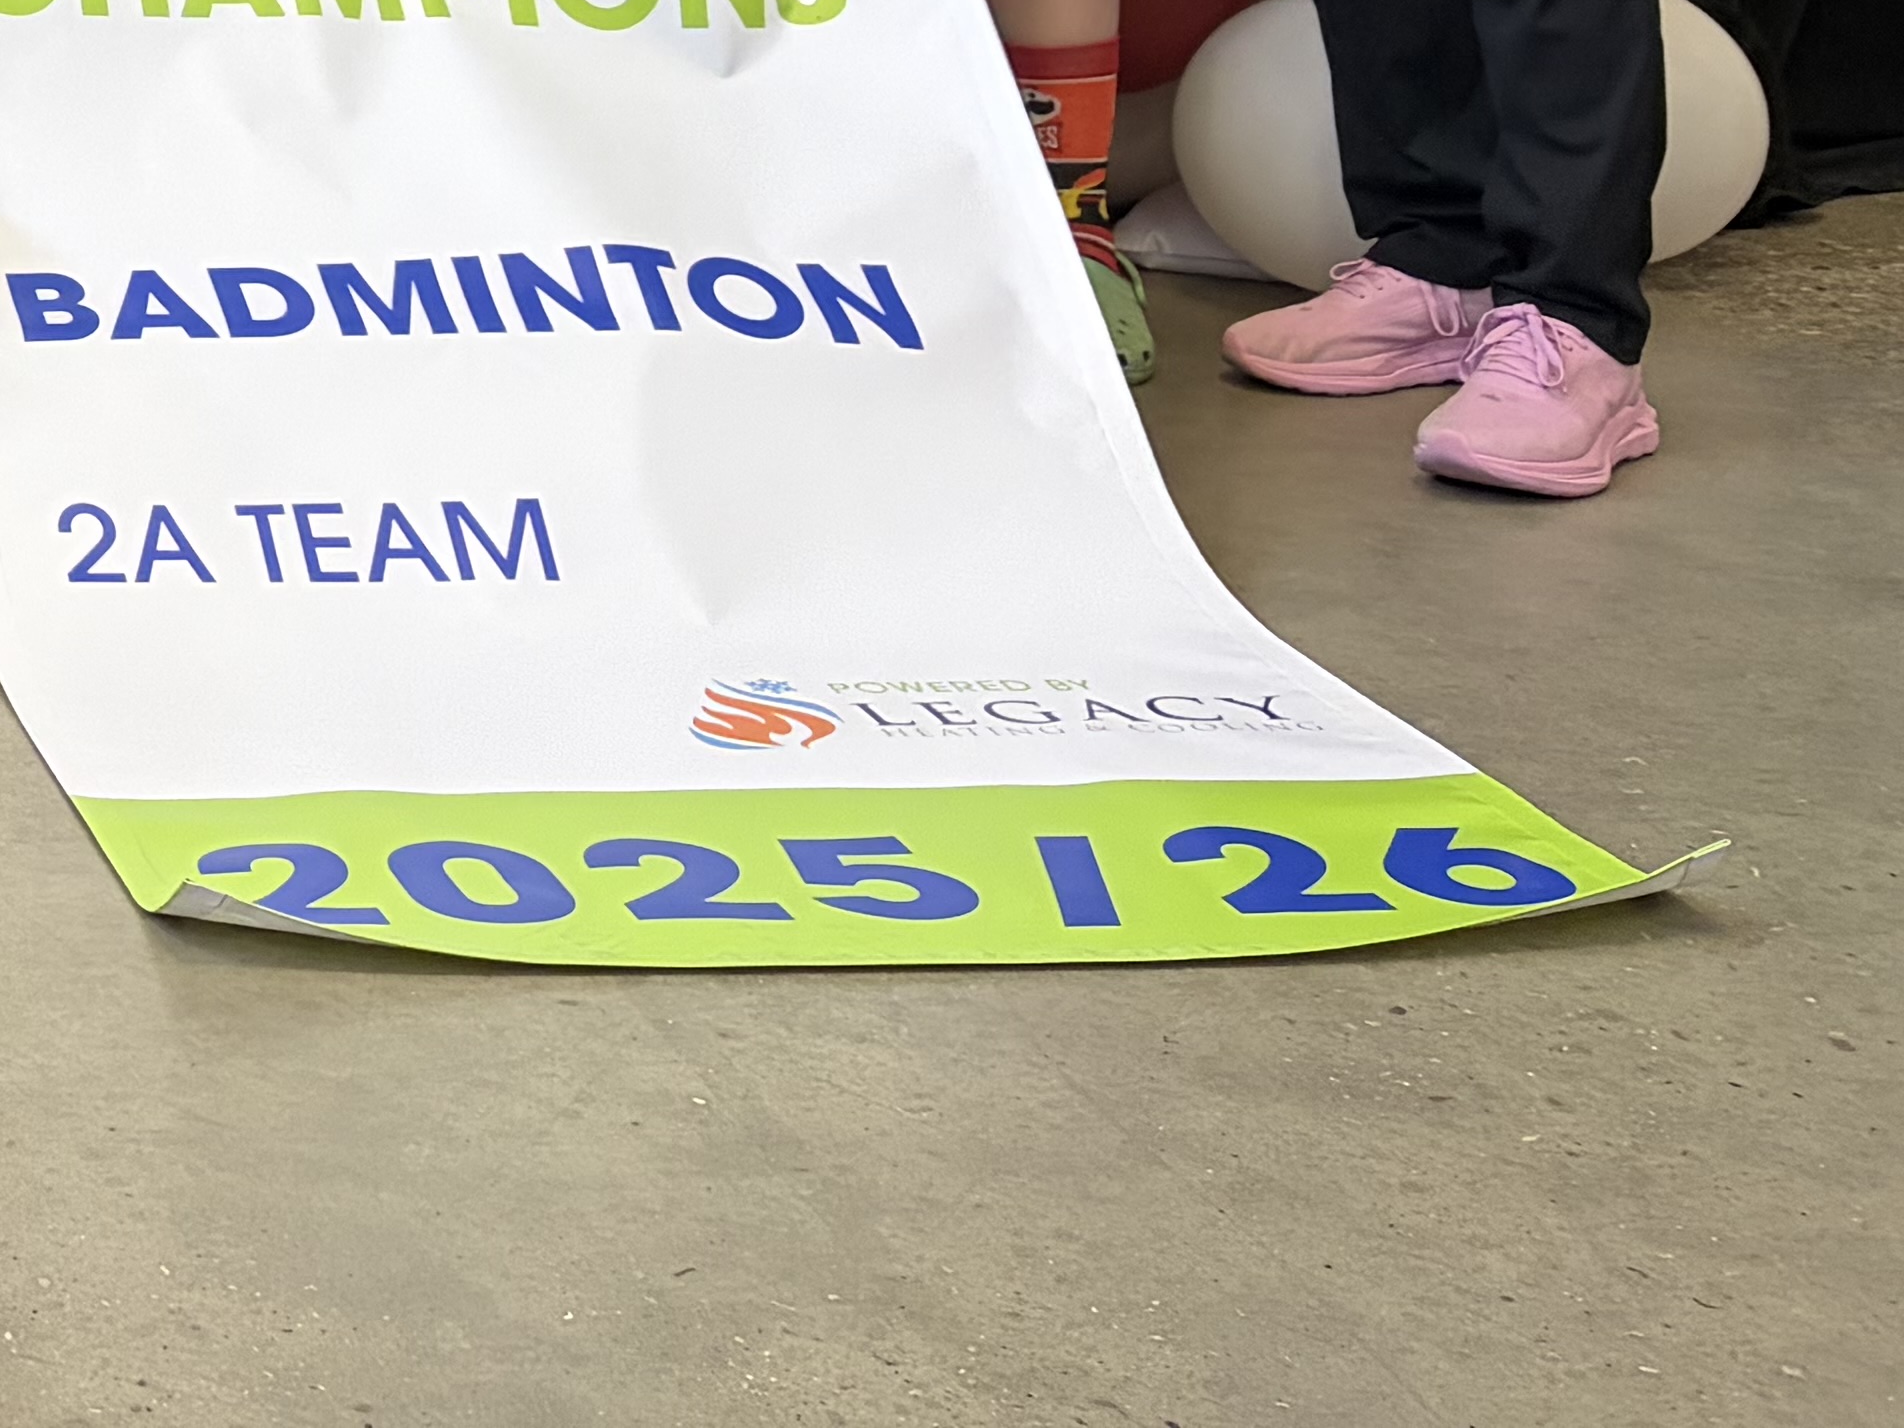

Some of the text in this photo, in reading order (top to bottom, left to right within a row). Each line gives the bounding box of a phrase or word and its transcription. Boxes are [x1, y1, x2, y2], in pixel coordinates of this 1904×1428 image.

[5, 243, 924, 353] BADMINTON
[55, 496, 562, 586] 2A TEAM
[827, 677, 1092, 695] POWERED BY
[853, 695, 1293, 727] LEGACY
[881, 724, 1066, 738] HEATING
[1128, 719, 1325, 734] COOLING
[196, 834, 984, 929] 2025
[1164, 824, 1580, 916] 26
